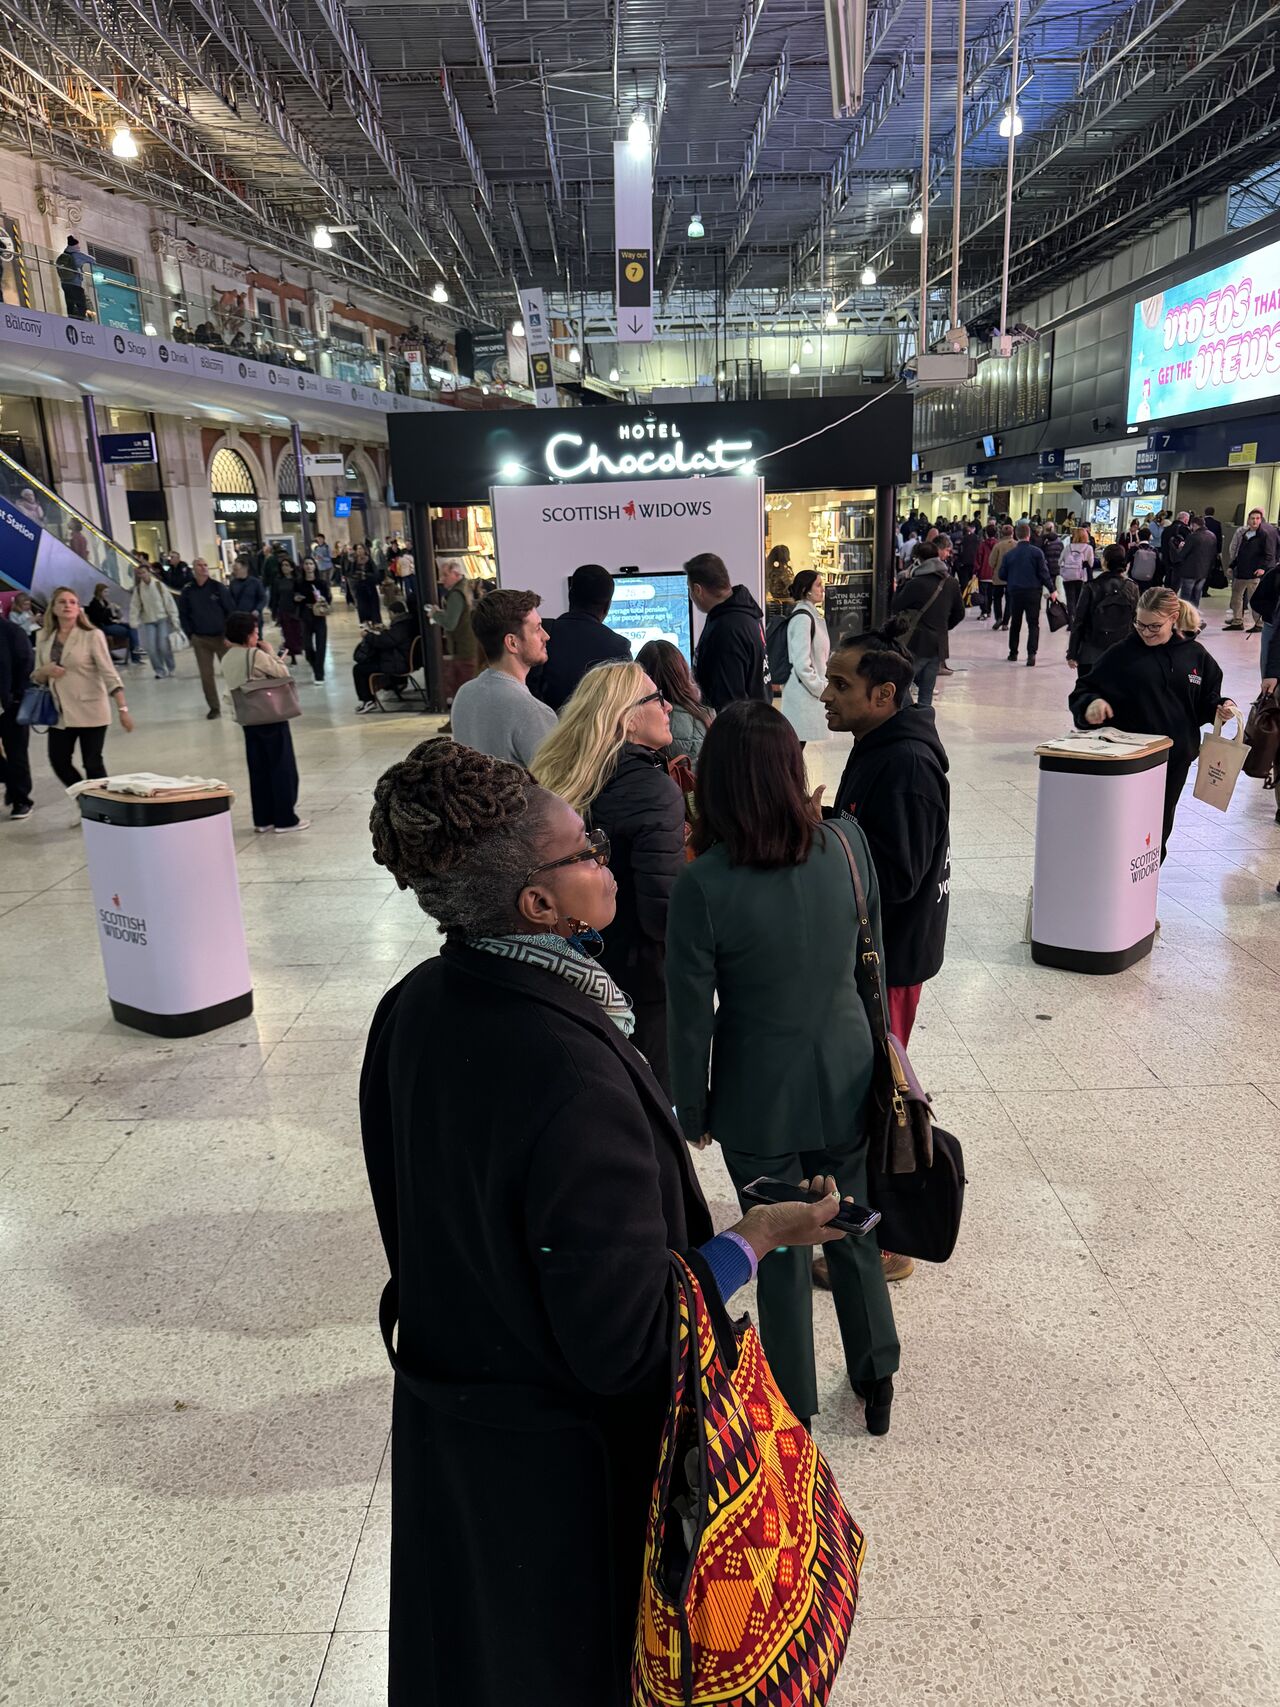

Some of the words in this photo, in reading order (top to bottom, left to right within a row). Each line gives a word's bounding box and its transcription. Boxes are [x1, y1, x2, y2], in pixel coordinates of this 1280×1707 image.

[621, 251, 636, 260] Way
[1163, 278, 1252, 351] VIDEOS
[5, 315, 42, 337] Balcony
[81, 331, 95, 345] Eat
[128, 341, 146, 358] Shop
[171, 351, 189, 364] Drink
[1158, 364, 1174, 385] GET
[1176, 360, 1192, 381] THE
[1195, 322, 1280, 390] VIEWS
[620, 424, 681, 439] HOTEL
[1162, 436, 1170, 447] 7
[545, 433, 753, 478] Chocolat
[1048, 453, 1055, 463] 6
[971, 466, 976, 474] 5
[542, 505, 620, 522] SCOTTISH
[639, 501, 712, 518] WIDOWS
[6, 514, 35, 541] Station
[621, 614, 641, 622] people
[645, 606, 667, 614] pension
[1130, 845, 1160, 871] SCOTTISH
[1131, 859, 1159, 883] WIDOWS
[99, 908, 147, 932] SCOTTISH
[103, 923, 147, 946] WIDOWS
